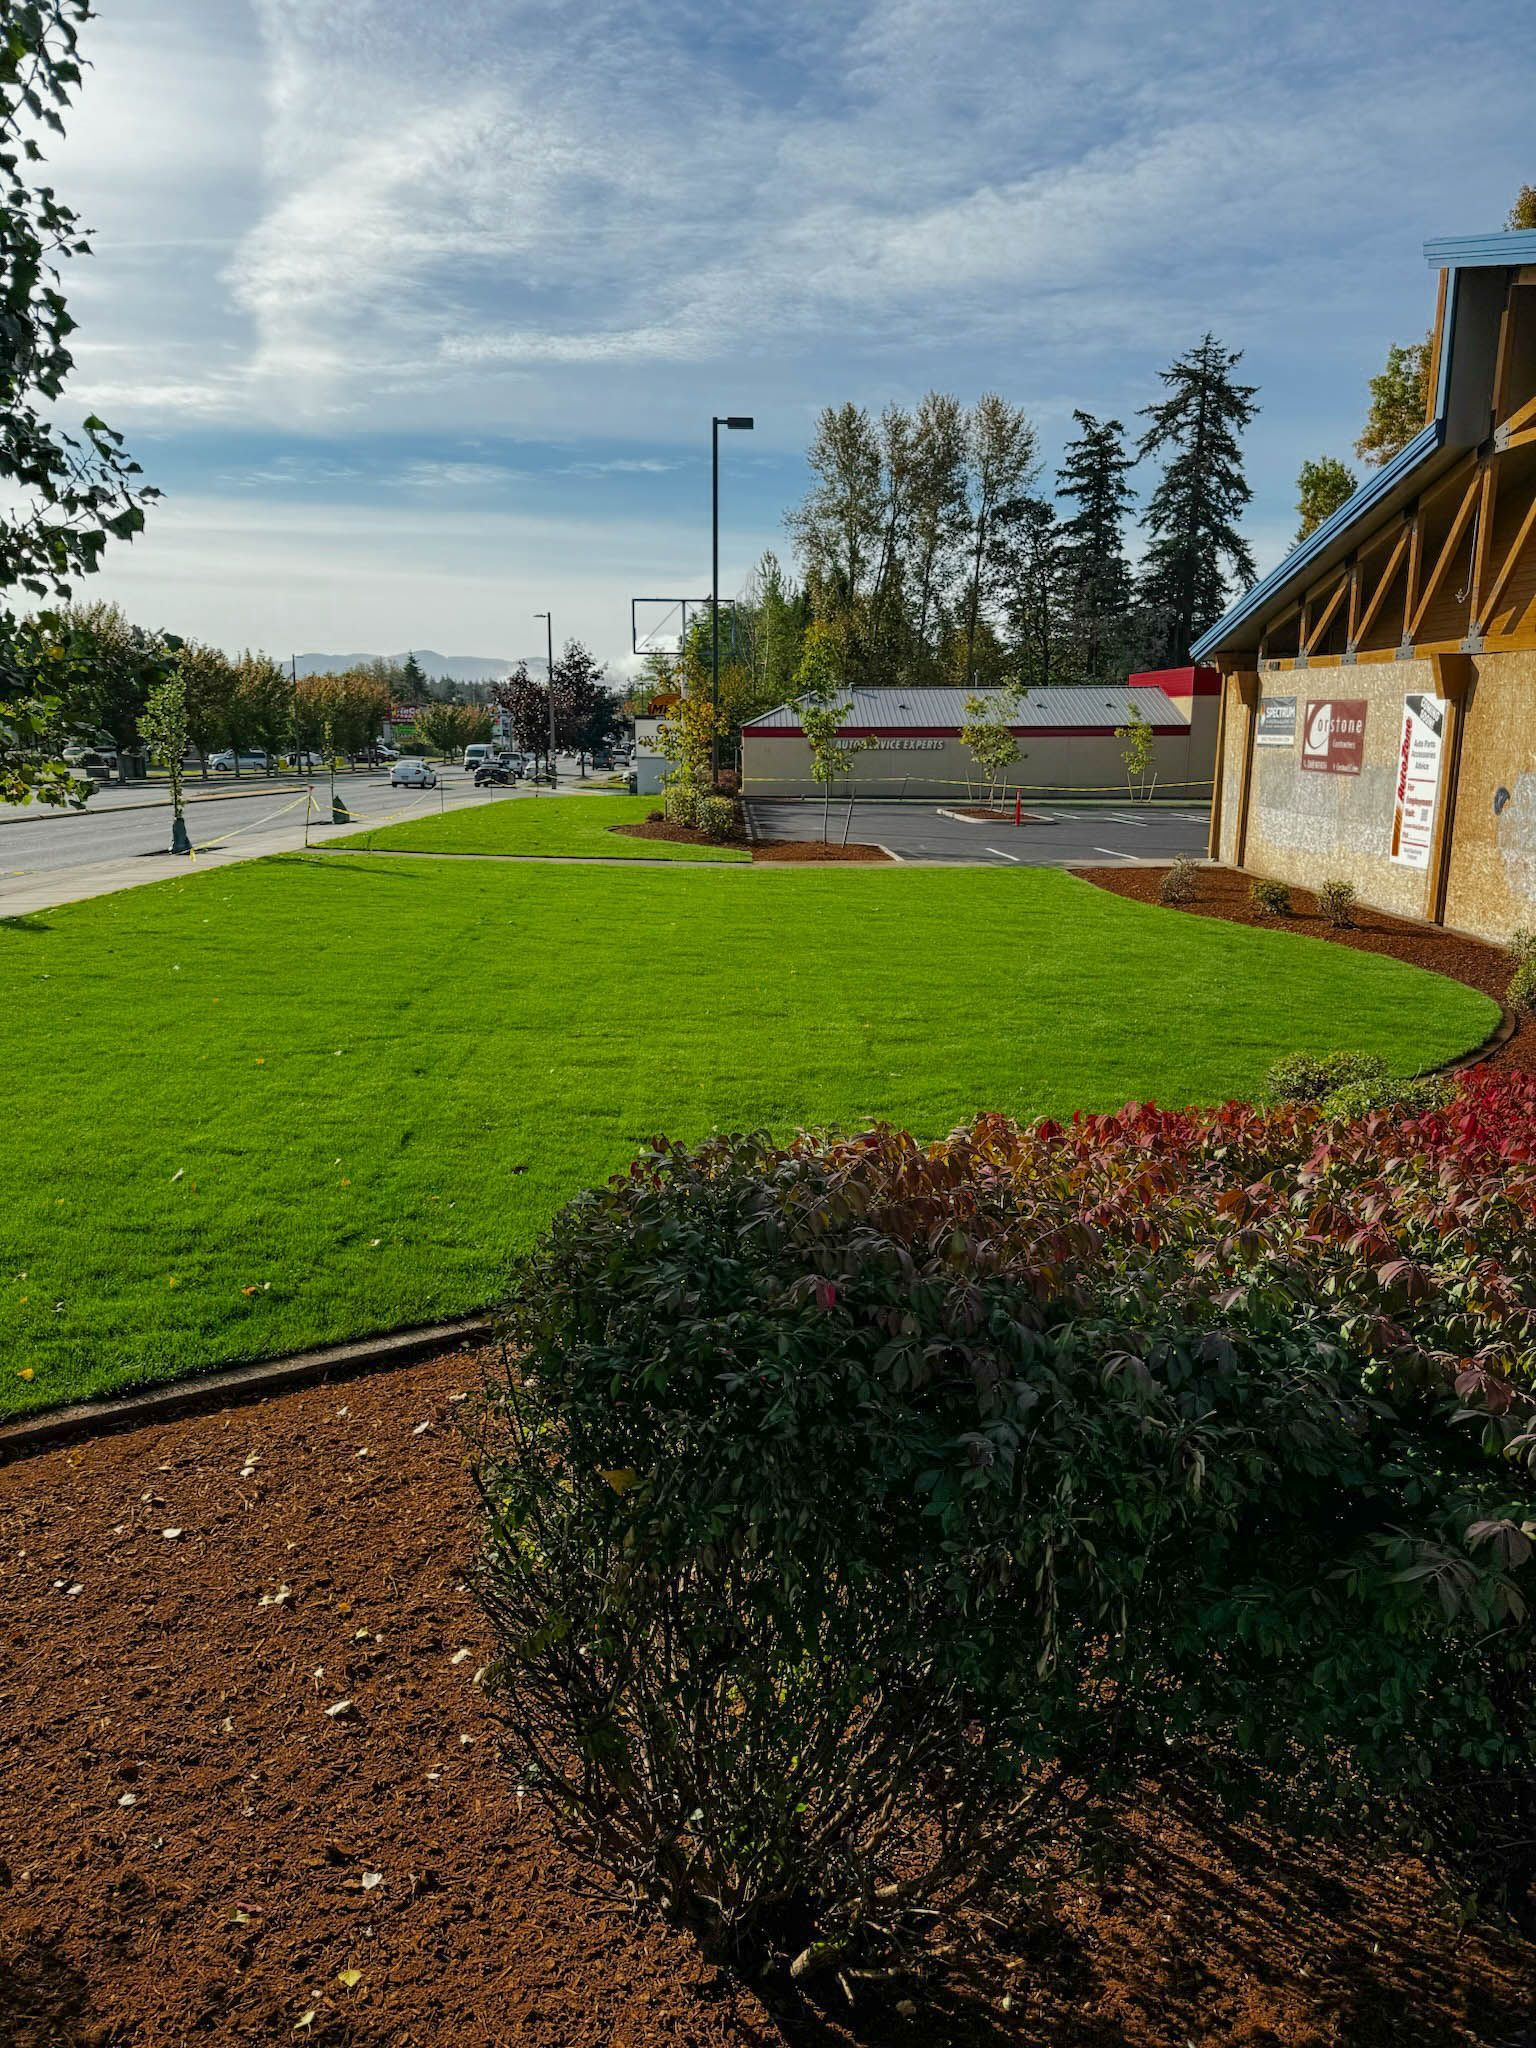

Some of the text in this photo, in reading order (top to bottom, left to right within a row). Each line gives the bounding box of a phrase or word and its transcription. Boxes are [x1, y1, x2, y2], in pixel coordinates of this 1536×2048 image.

[1266, 706, 1296, 718] SPECTRUM
[902, 740, 944, 750] EXPERTS
[1397, 717, 1413, 801] AutoZone
